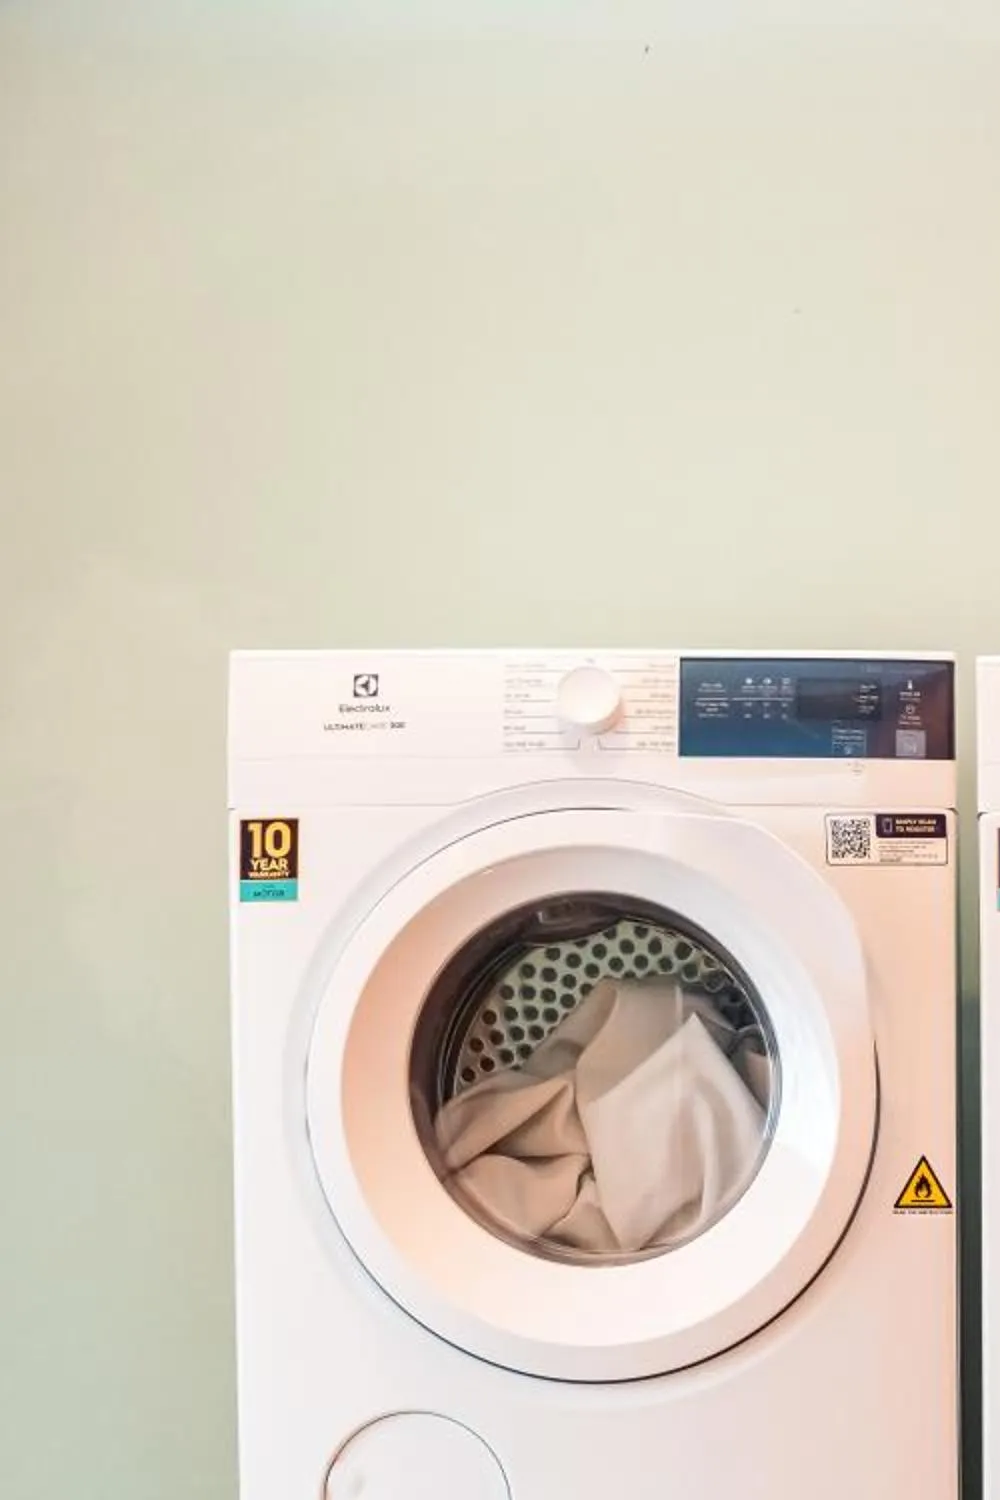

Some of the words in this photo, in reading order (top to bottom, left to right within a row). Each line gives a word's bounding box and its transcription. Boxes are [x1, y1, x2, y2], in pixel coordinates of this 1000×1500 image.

[338, 703, 391, 713] Electrolux
[247, 821, 291, 858] 10
[250, 857, 289, 871] YEAR
